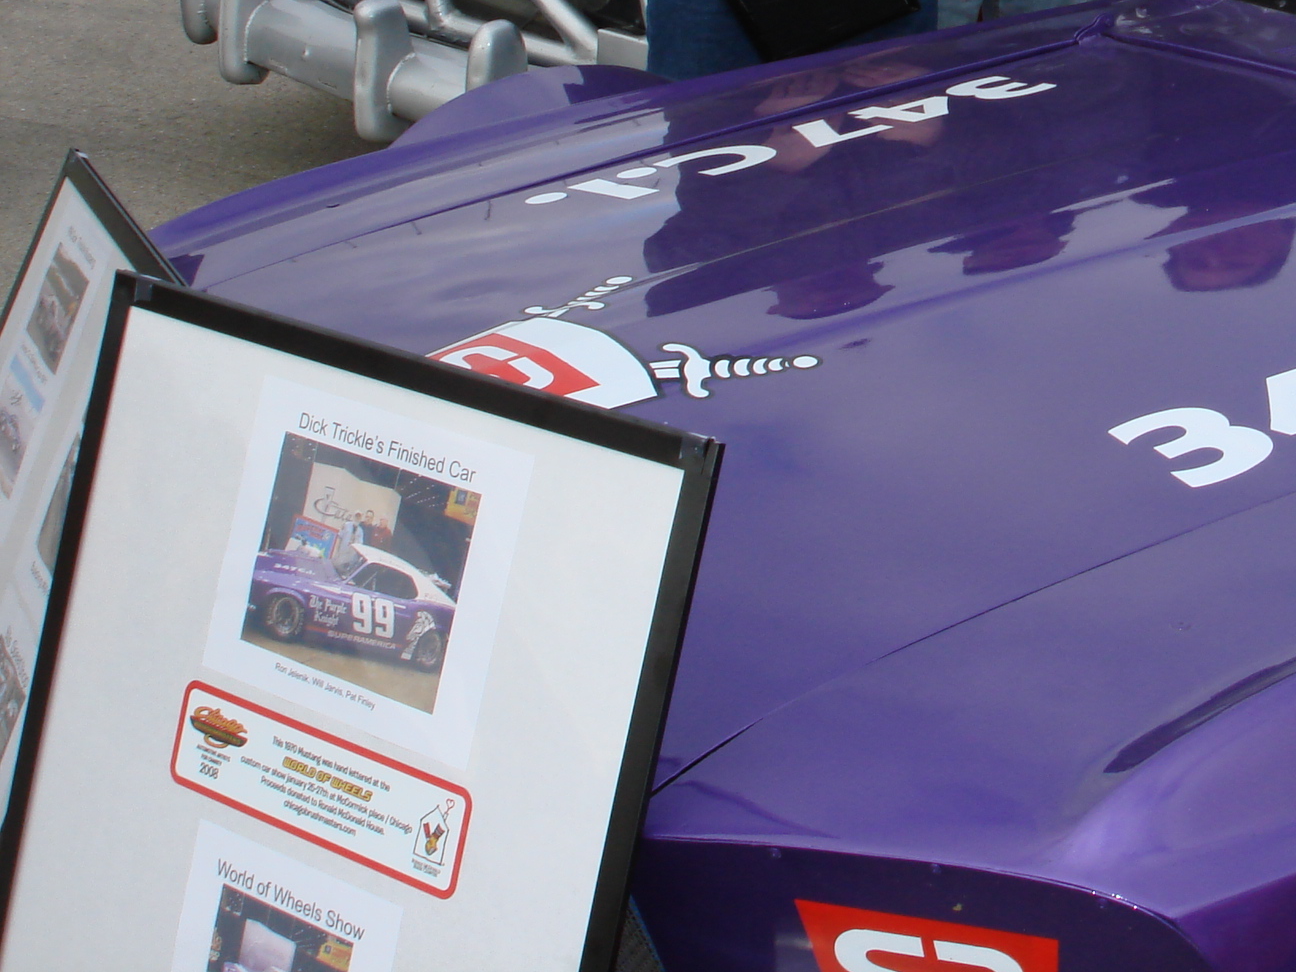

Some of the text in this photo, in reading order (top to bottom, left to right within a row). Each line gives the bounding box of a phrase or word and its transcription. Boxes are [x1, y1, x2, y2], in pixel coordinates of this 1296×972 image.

[298, 411, 477, 485] Dick Trickle's Finished Car
[314, 611, 340, 629] Knight
[324, 598, 348, 615] Purple
[351, 592, 396, 639] 99
[327, 629, 397, 650] SUPERAMERICA
[274, 661, 287, 675] Ron
[311, 676, 324, 689] Will
[345, 690, 357, 702] Pat
[199, 762, 219, 780] 2008
[272, 735, 284, 748] This
[297, 746, 322, 766] Mustang
[321, 758, 333, 769] was
[333, 760, 348, 775] hand
[348, 766, 373, 784] lettered
[380, 780, 391, 792] the
[282, 755, 374, 802] WORLD OF WHEELS
[240, 755, 262, 770] custom
[261, 763, 272, 773] car
[271, 767, 287, 781] show
[336, 793, 368, 816] McCormick
[367, 806, 386, 823] place
[389, 818, 413, 835] Chicago
[260, 775, 288, 794] Proceeds
[286, 786, 311, 804] donated
[317, 799, 338, 816] Ronald
[337, 808, 367, 828] McDonald
[217, 857, 366, 942] World of Wheels Show
